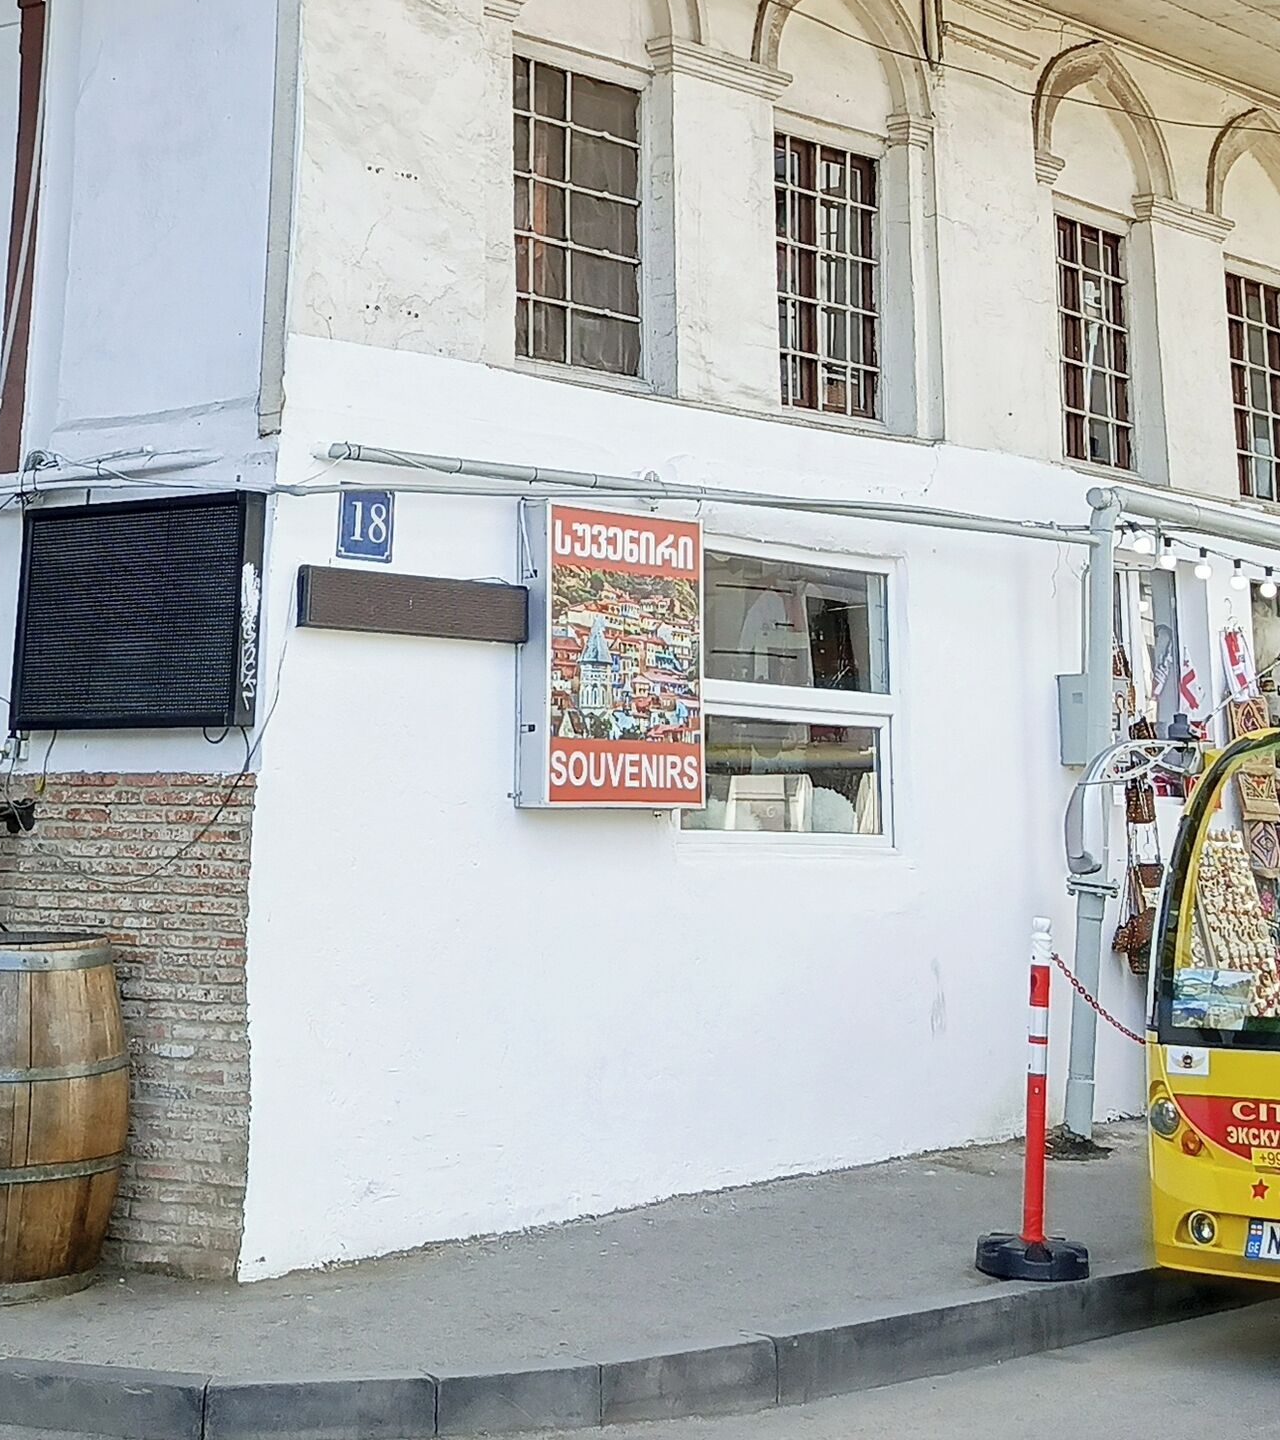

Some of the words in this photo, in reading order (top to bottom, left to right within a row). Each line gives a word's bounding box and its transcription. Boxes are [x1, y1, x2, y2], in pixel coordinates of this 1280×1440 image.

[350, 502, 387, 544] 18
[554, 519, 694, 571] სუვენირი
[551, 749, 699, 790] SOUVENIRS
[1247, 1241, 1260, 1254] GE
